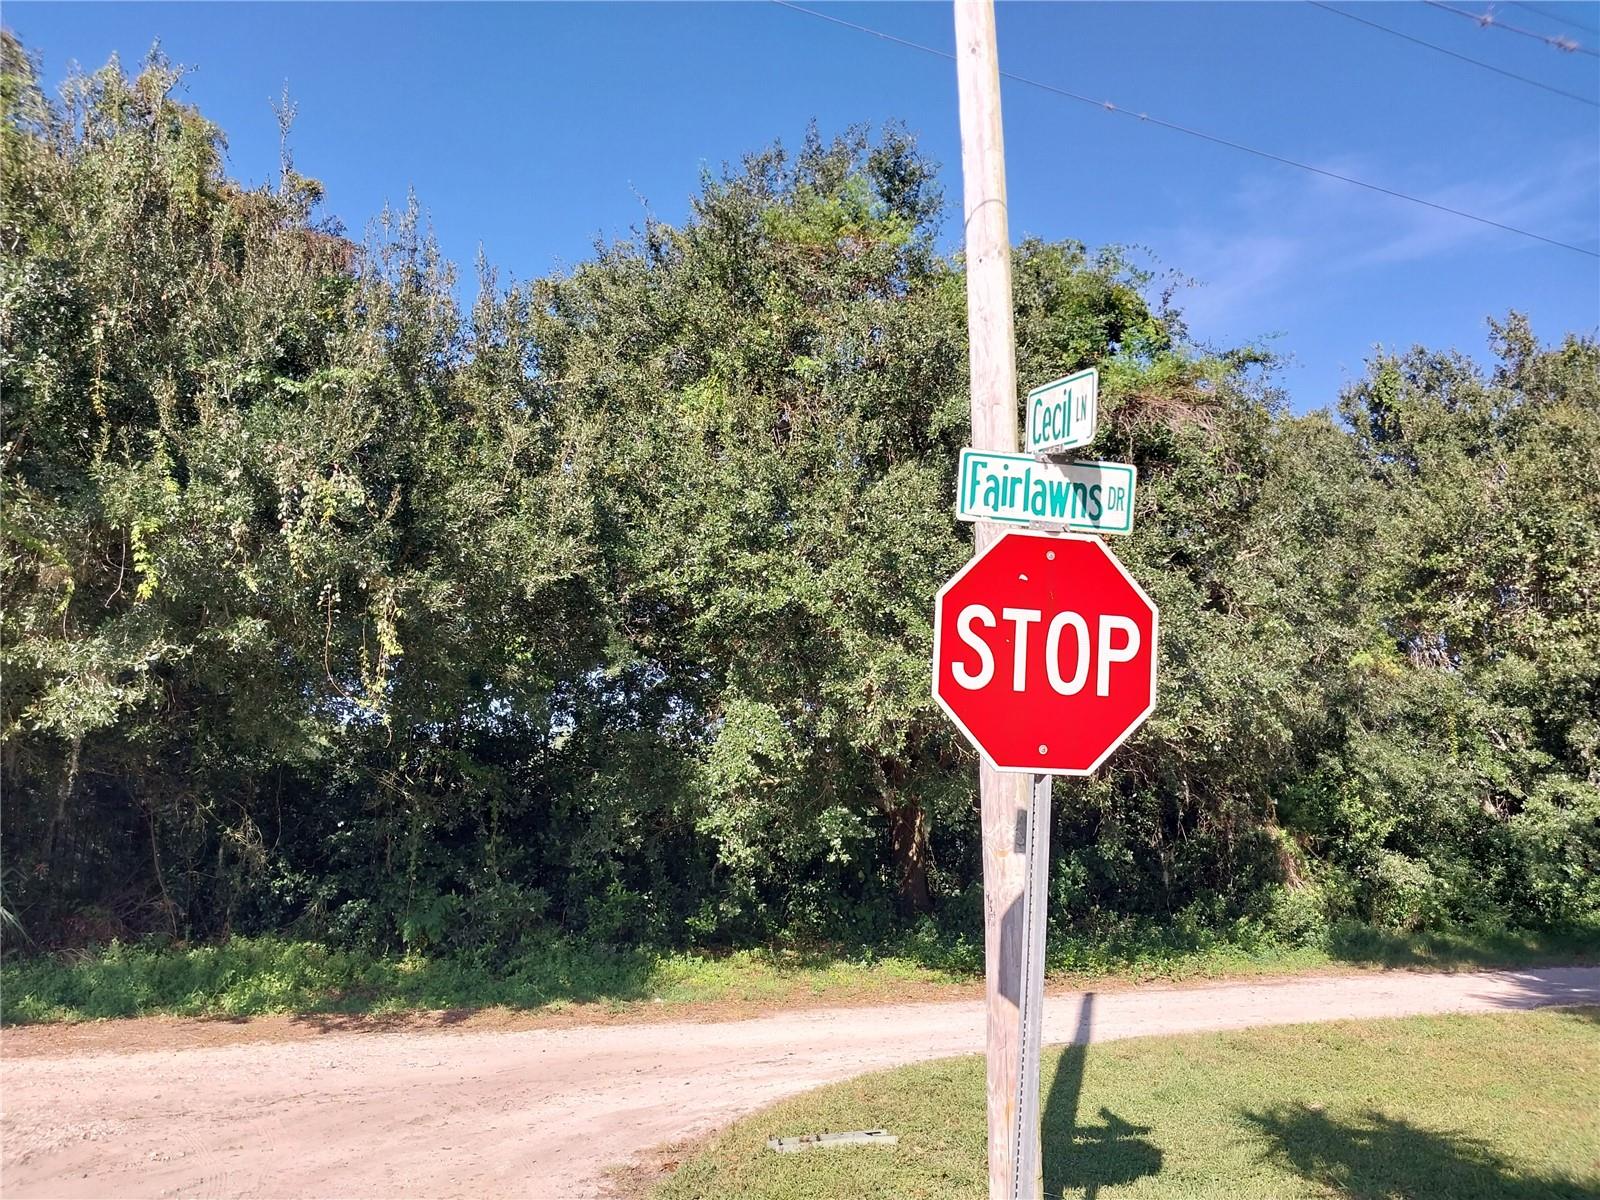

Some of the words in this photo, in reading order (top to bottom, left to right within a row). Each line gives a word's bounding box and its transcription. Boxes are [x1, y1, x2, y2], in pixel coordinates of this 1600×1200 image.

[1033, 388, 1070, 444] Cecil
[1076, 394, 1087, 422] LN
[970, 461, 1102, 521] Fairlawns
[1108, 486, 1125, 512] DR
[951, 604, 1141, 697] STOP
